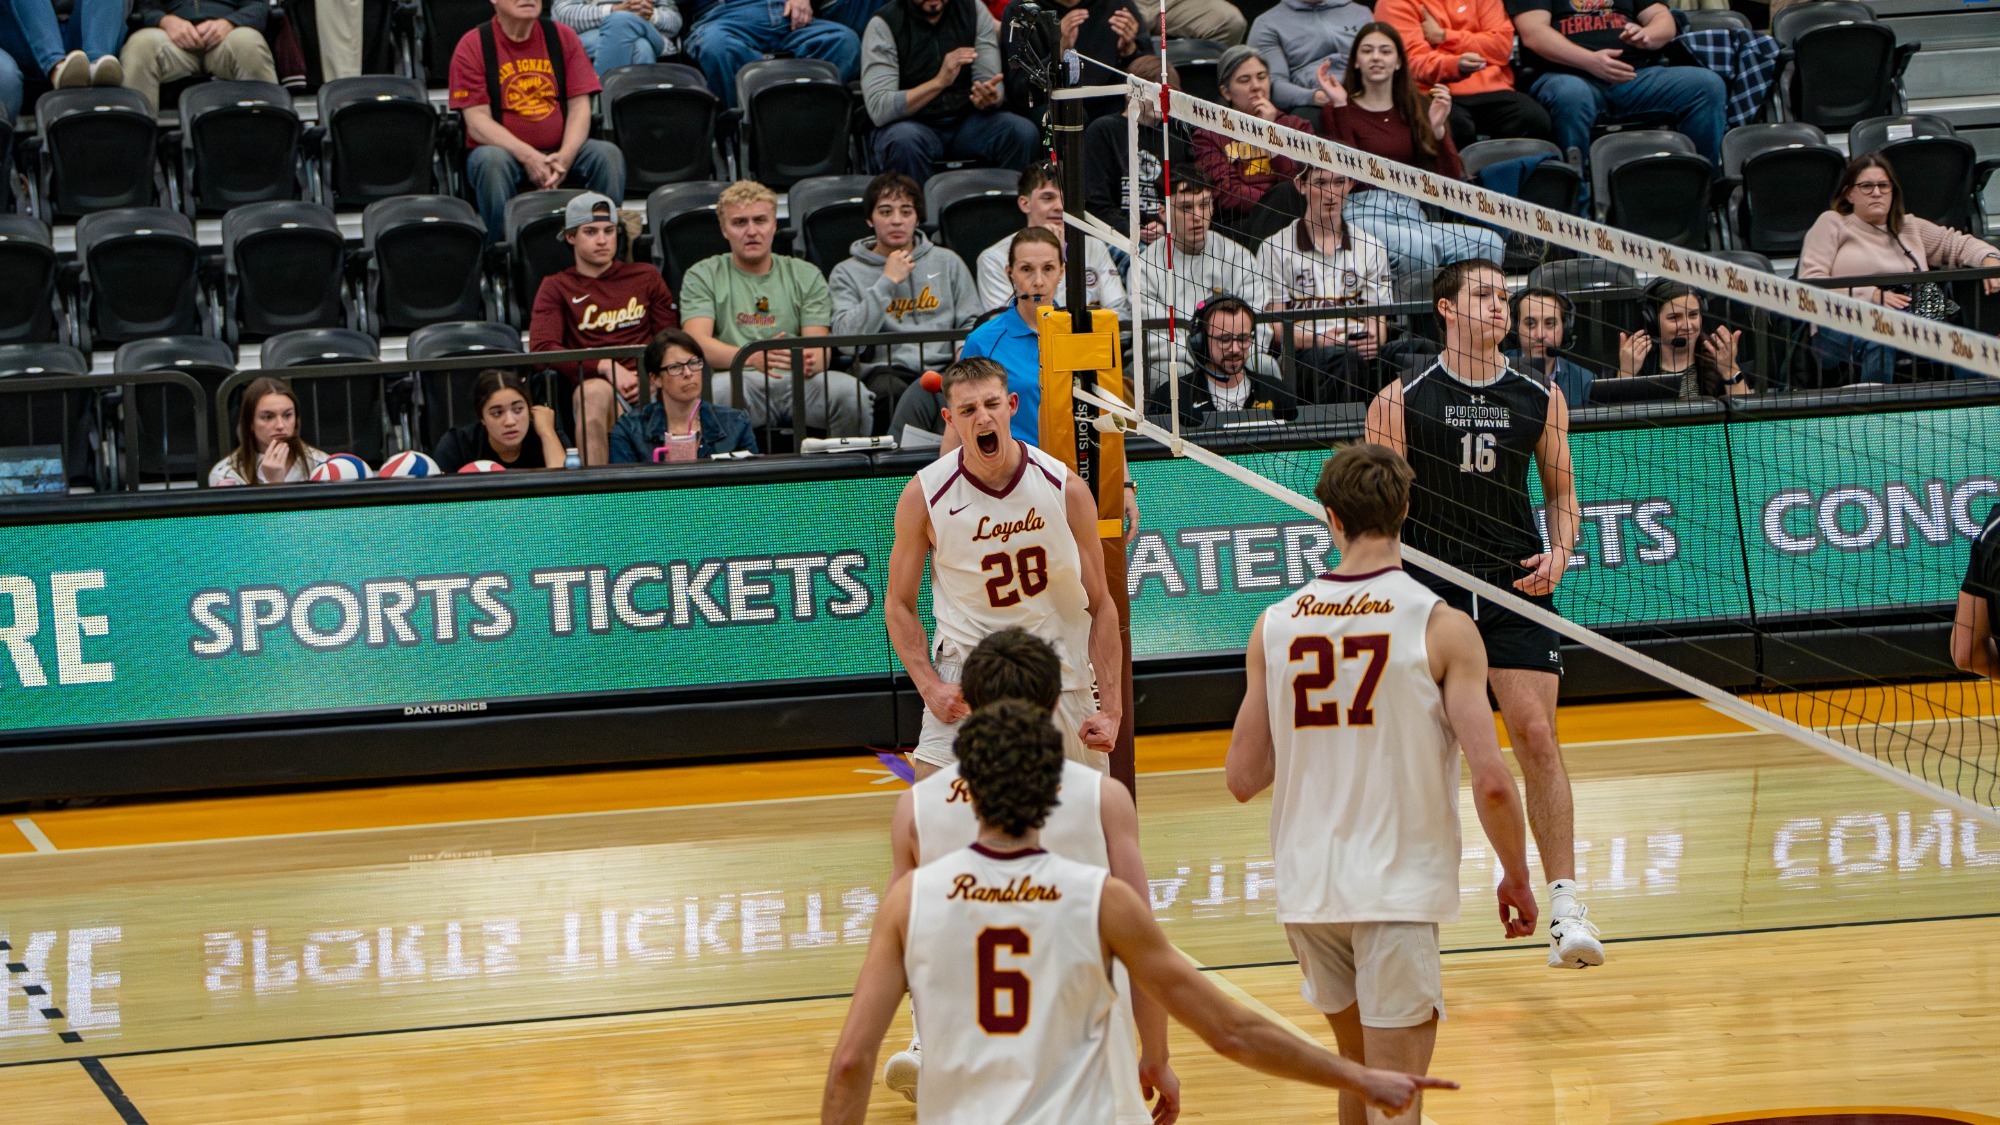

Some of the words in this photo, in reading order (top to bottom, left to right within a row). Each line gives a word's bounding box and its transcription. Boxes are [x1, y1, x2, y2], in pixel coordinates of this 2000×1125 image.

[577, 296, 646, 332] Loyola
[885, 285, 941, 319] oyola
[1445, 405, 1510, 420] PURDUE
[1445, 419, 1472, 428] FORT
[1475, 419, 1510, 429] WAYNE
[1459, 432, 1497, 474] 16
[972, 507, 1045, 542] Loyola
[980, 545, 1049, 608] 28
[190, 573, 515, 656] SPORTS
[533, 553, 870, 633] TICKETS
[1291, 592, 1395, 618] Ramblers
[1288, 632, 1392, 731] 27
[404, 701, 488, 716] DAKTRONICS
[946, 872, 1062, 903] Ramblers
[976, 925, 1032, 1036] 6
